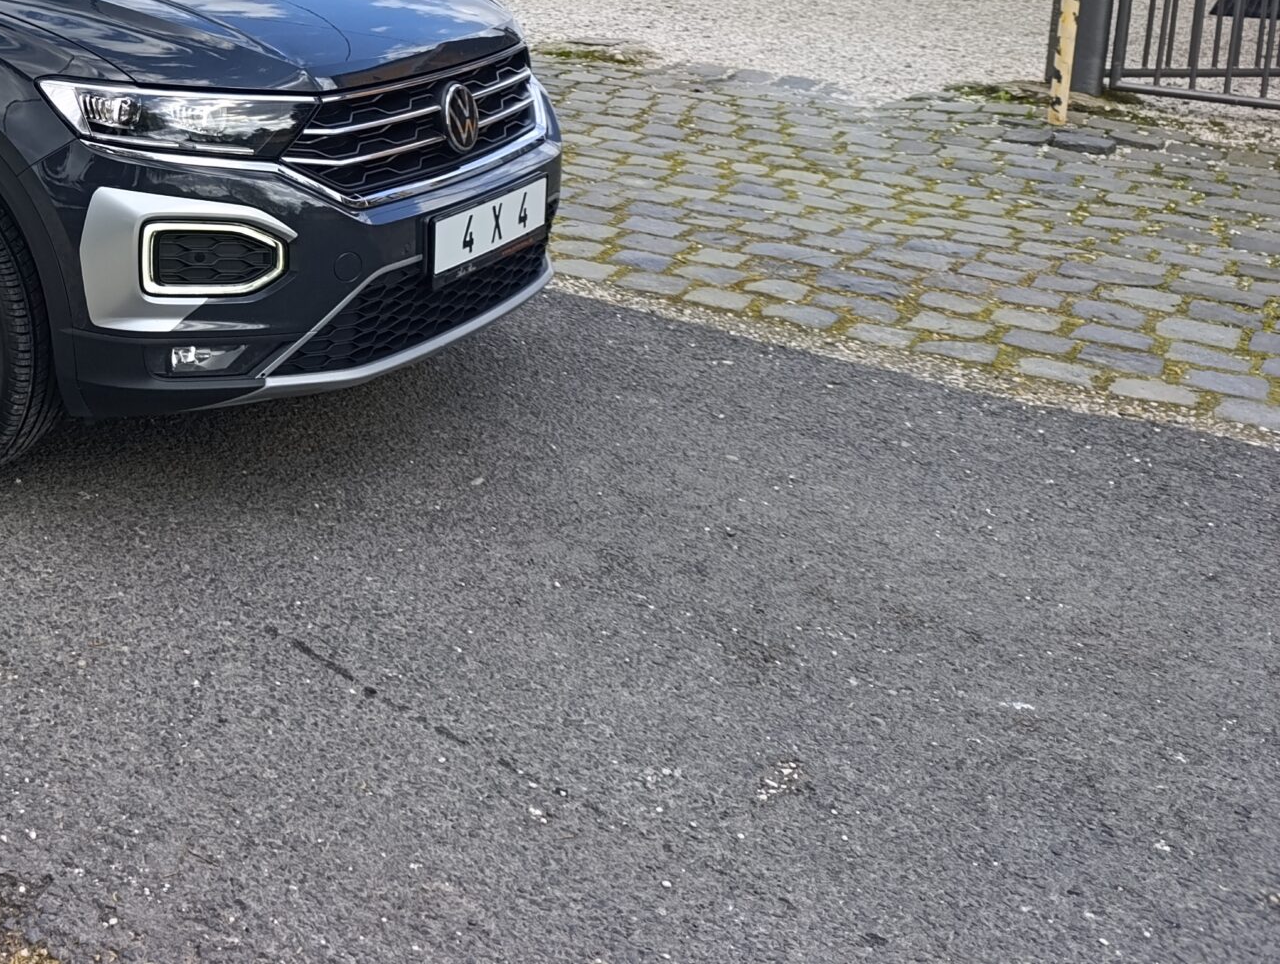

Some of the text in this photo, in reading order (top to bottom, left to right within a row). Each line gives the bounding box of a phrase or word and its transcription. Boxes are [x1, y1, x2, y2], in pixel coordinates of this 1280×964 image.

[462, 214, 474, 253] 4
[491, 202, 503, 245] X
[517, 191, 528, 229] 4
